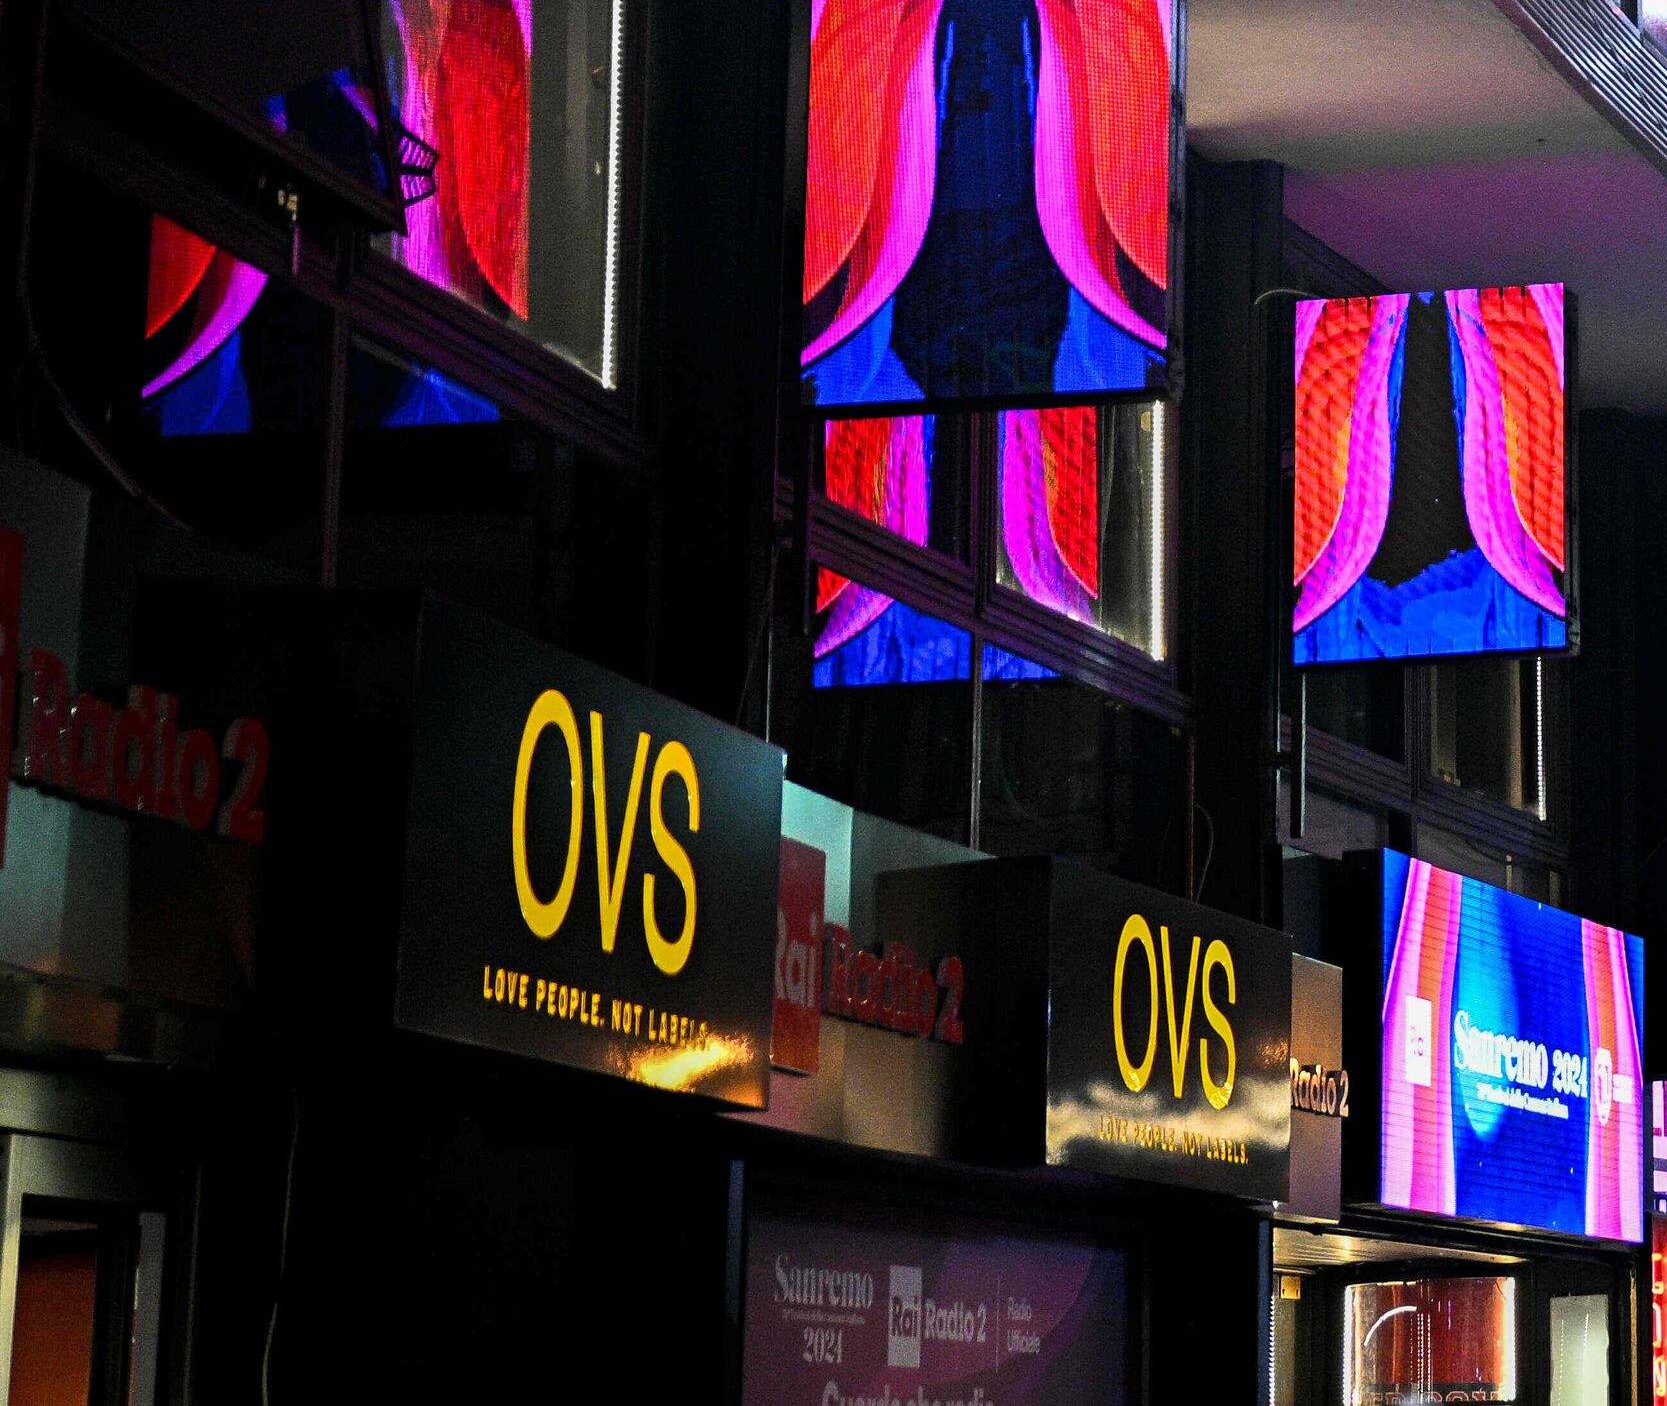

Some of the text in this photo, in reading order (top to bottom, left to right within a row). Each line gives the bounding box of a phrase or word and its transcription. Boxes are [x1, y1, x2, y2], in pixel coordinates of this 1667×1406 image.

[26, 647, 271, 847] Radio 2
[513, 690, 700, 975] OVS
[484, 965, 530, 1009] LOVE
[611, 999, 644, 1036] NOT
[826, 923, 938, 1041] Radio
[936, 954, 965, 1045] 2
[1113, 914, 1236, 1110] OVS
[1290, 1057, 1349, 1117] Radio 2
[1454, 1009, 1549, 1090] Sanremo
[1552, 1049, 1589, 1099] 2024
[1100, 1115, 1128, 1143] LOVE
[1182, 1131, 1203, 1156] NOT
[774, 1252, 874, 1309] Sanremo
[924, 1297, 974, 1341] Radio
[976, 1303, 988, 1343] 2
